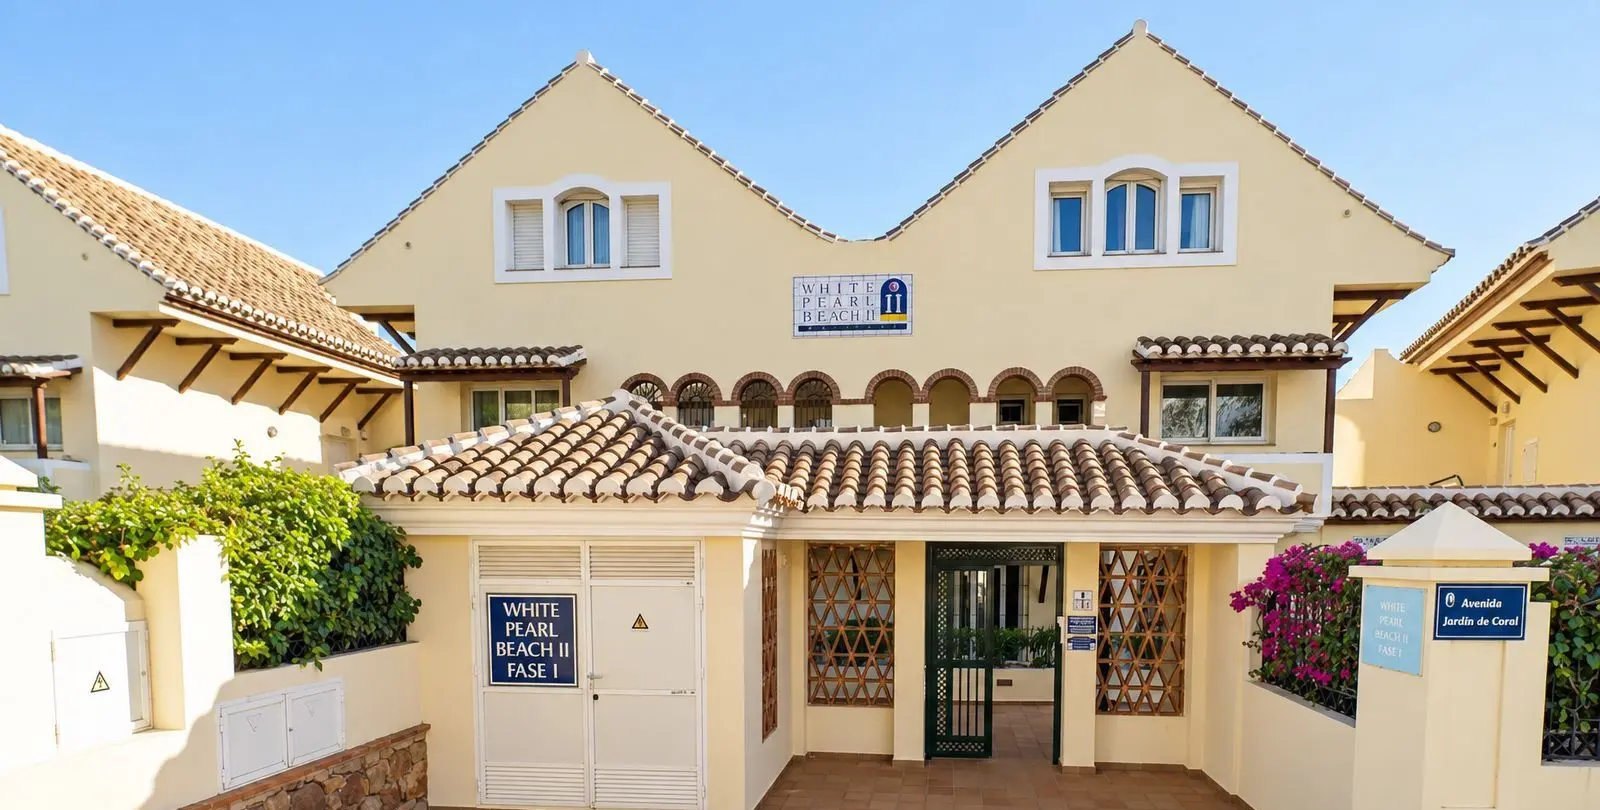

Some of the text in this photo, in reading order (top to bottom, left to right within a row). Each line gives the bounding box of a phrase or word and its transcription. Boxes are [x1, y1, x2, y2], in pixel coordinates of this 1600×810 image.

[802, 282, 874, 294] WHITE
[802, 296, 874, 308] PEARL
[803, 309, 875, 322] BEACH II
[1379, 600, 1406, 613] WHITE
[1461, 598, 1502, 608] Avenida
[503, 602, 560, 618] WHITE
[1379, 615, 1403, 628] PEARL
[1442, 616, 1519, 627] Jardín de Coral
[505, 621, 559, 637] PEARL
[1375, 629, 1401, 642] BEACH
[496, 641, 569, 657] BEACH II
[1378, 644, 1397, 657] FASE
[507, 662, 558, 679] FASE I
